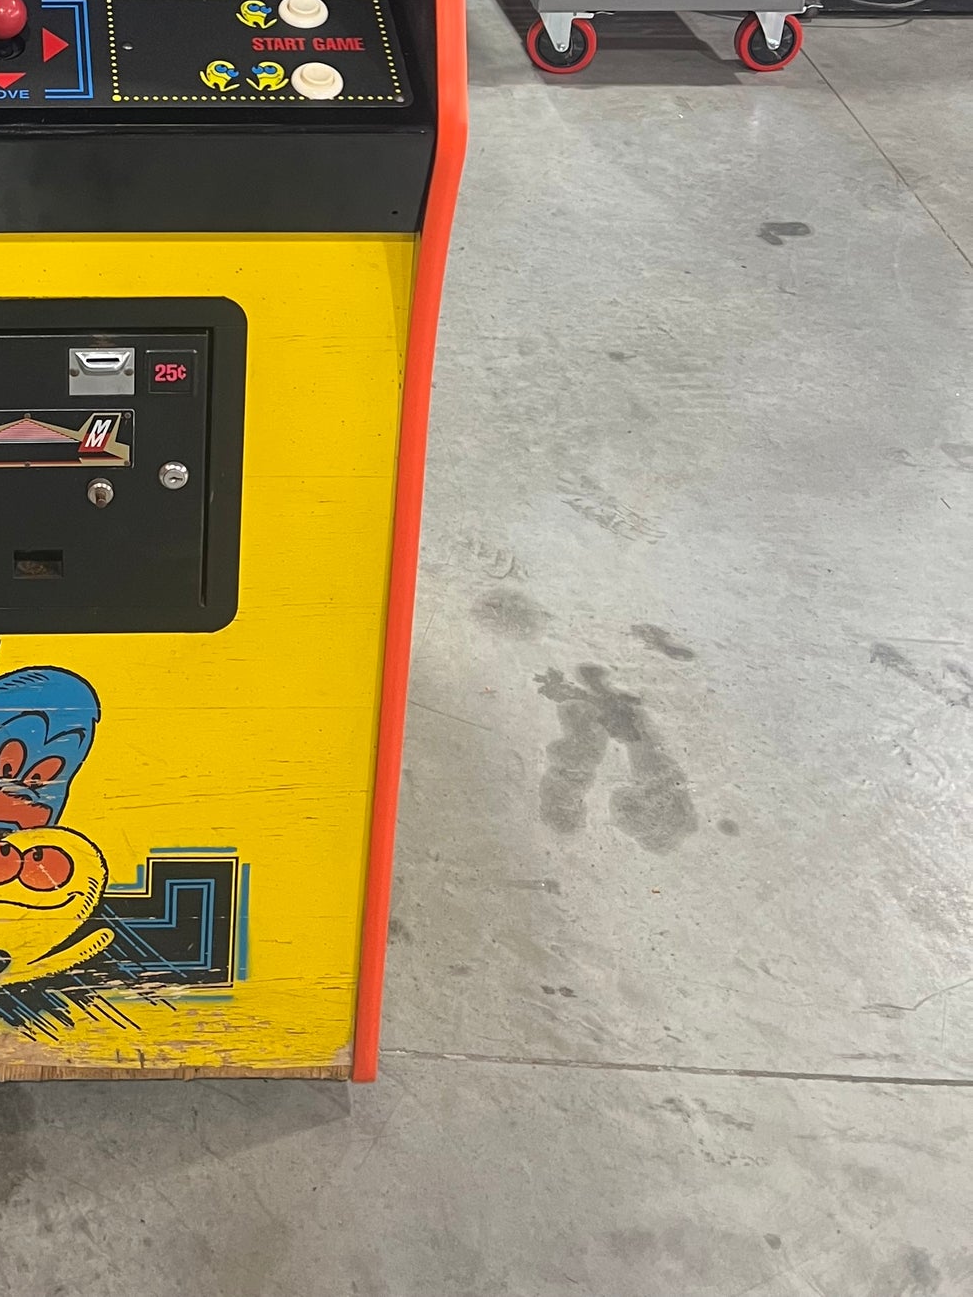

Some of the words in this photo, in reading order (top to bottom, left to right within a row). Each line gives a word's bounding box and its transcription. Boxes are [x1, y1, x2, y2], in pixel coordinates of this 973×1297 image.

[252, 37, 306, 51] START
[312, 37, 366, 51] GAME
[154, 364, 187, 382] 25¢
